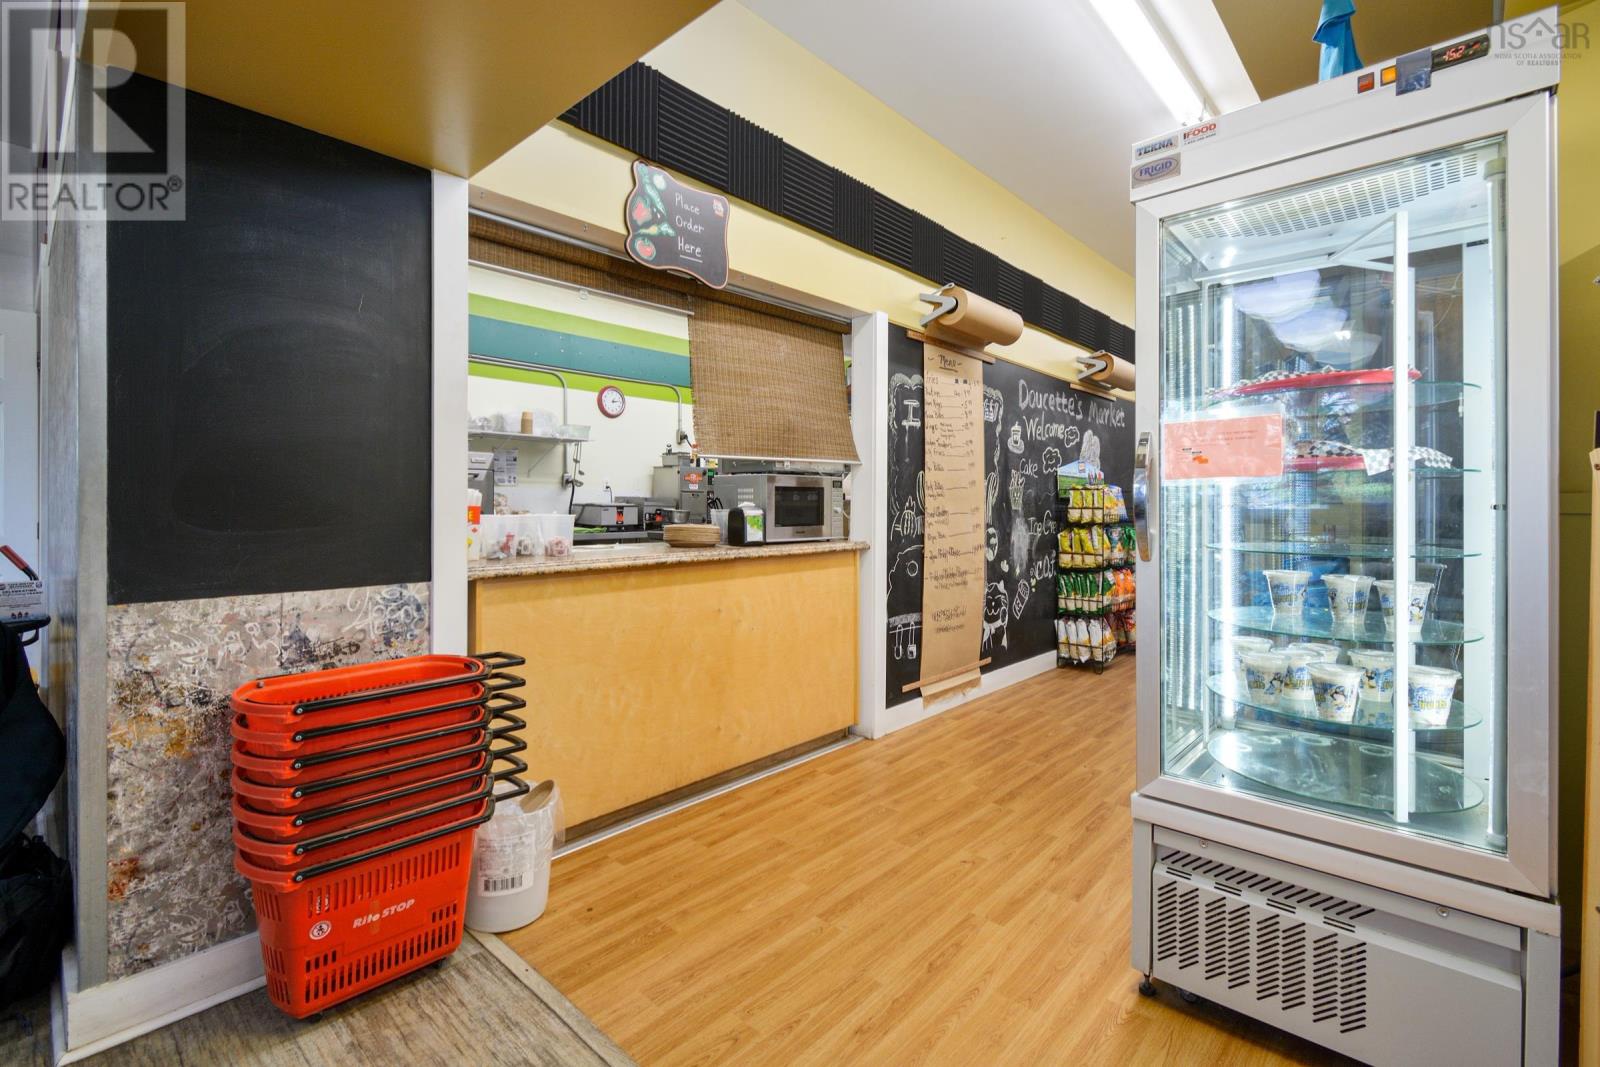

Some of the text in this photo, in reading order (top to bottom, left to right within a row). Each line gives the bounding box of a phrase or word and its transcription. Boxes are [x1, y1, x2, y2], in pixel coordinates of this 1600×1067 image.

[1139, 160, 1173, 177] FRIGID
[675, 192, 701, 215] Place
[675, 215, 705, 233] Order
[678, 236, 702, 257] Here
[1018, 379, 1083, 420] Doucette's
[1088, 400, 1125, 428] Market
[1023, 411, 1065, 441] Welcome
[1020, 458, 1038, 478] Cake
[381, 898, 415, 918] STOP
